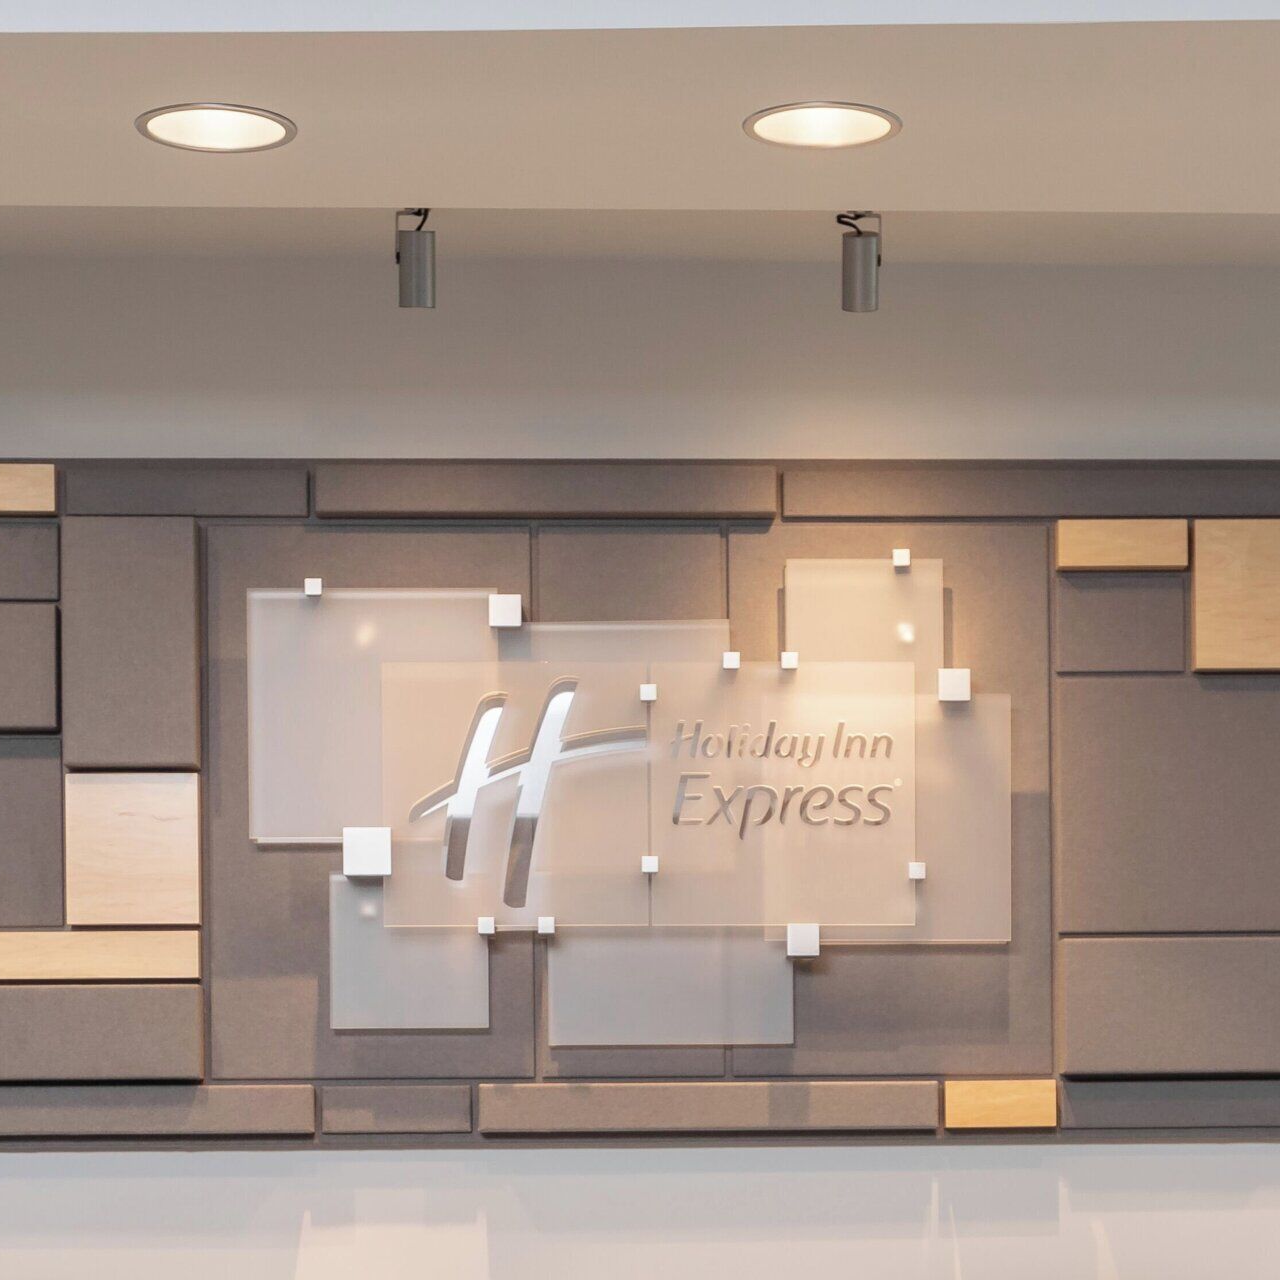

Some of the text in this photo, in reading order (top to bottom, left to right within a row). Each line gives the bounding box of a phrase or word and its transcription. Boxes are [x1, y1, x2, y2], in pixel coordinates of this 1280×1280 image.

[670, 719, 894, 768] Holiday Inn
[672, 771, 895, 840] Express
